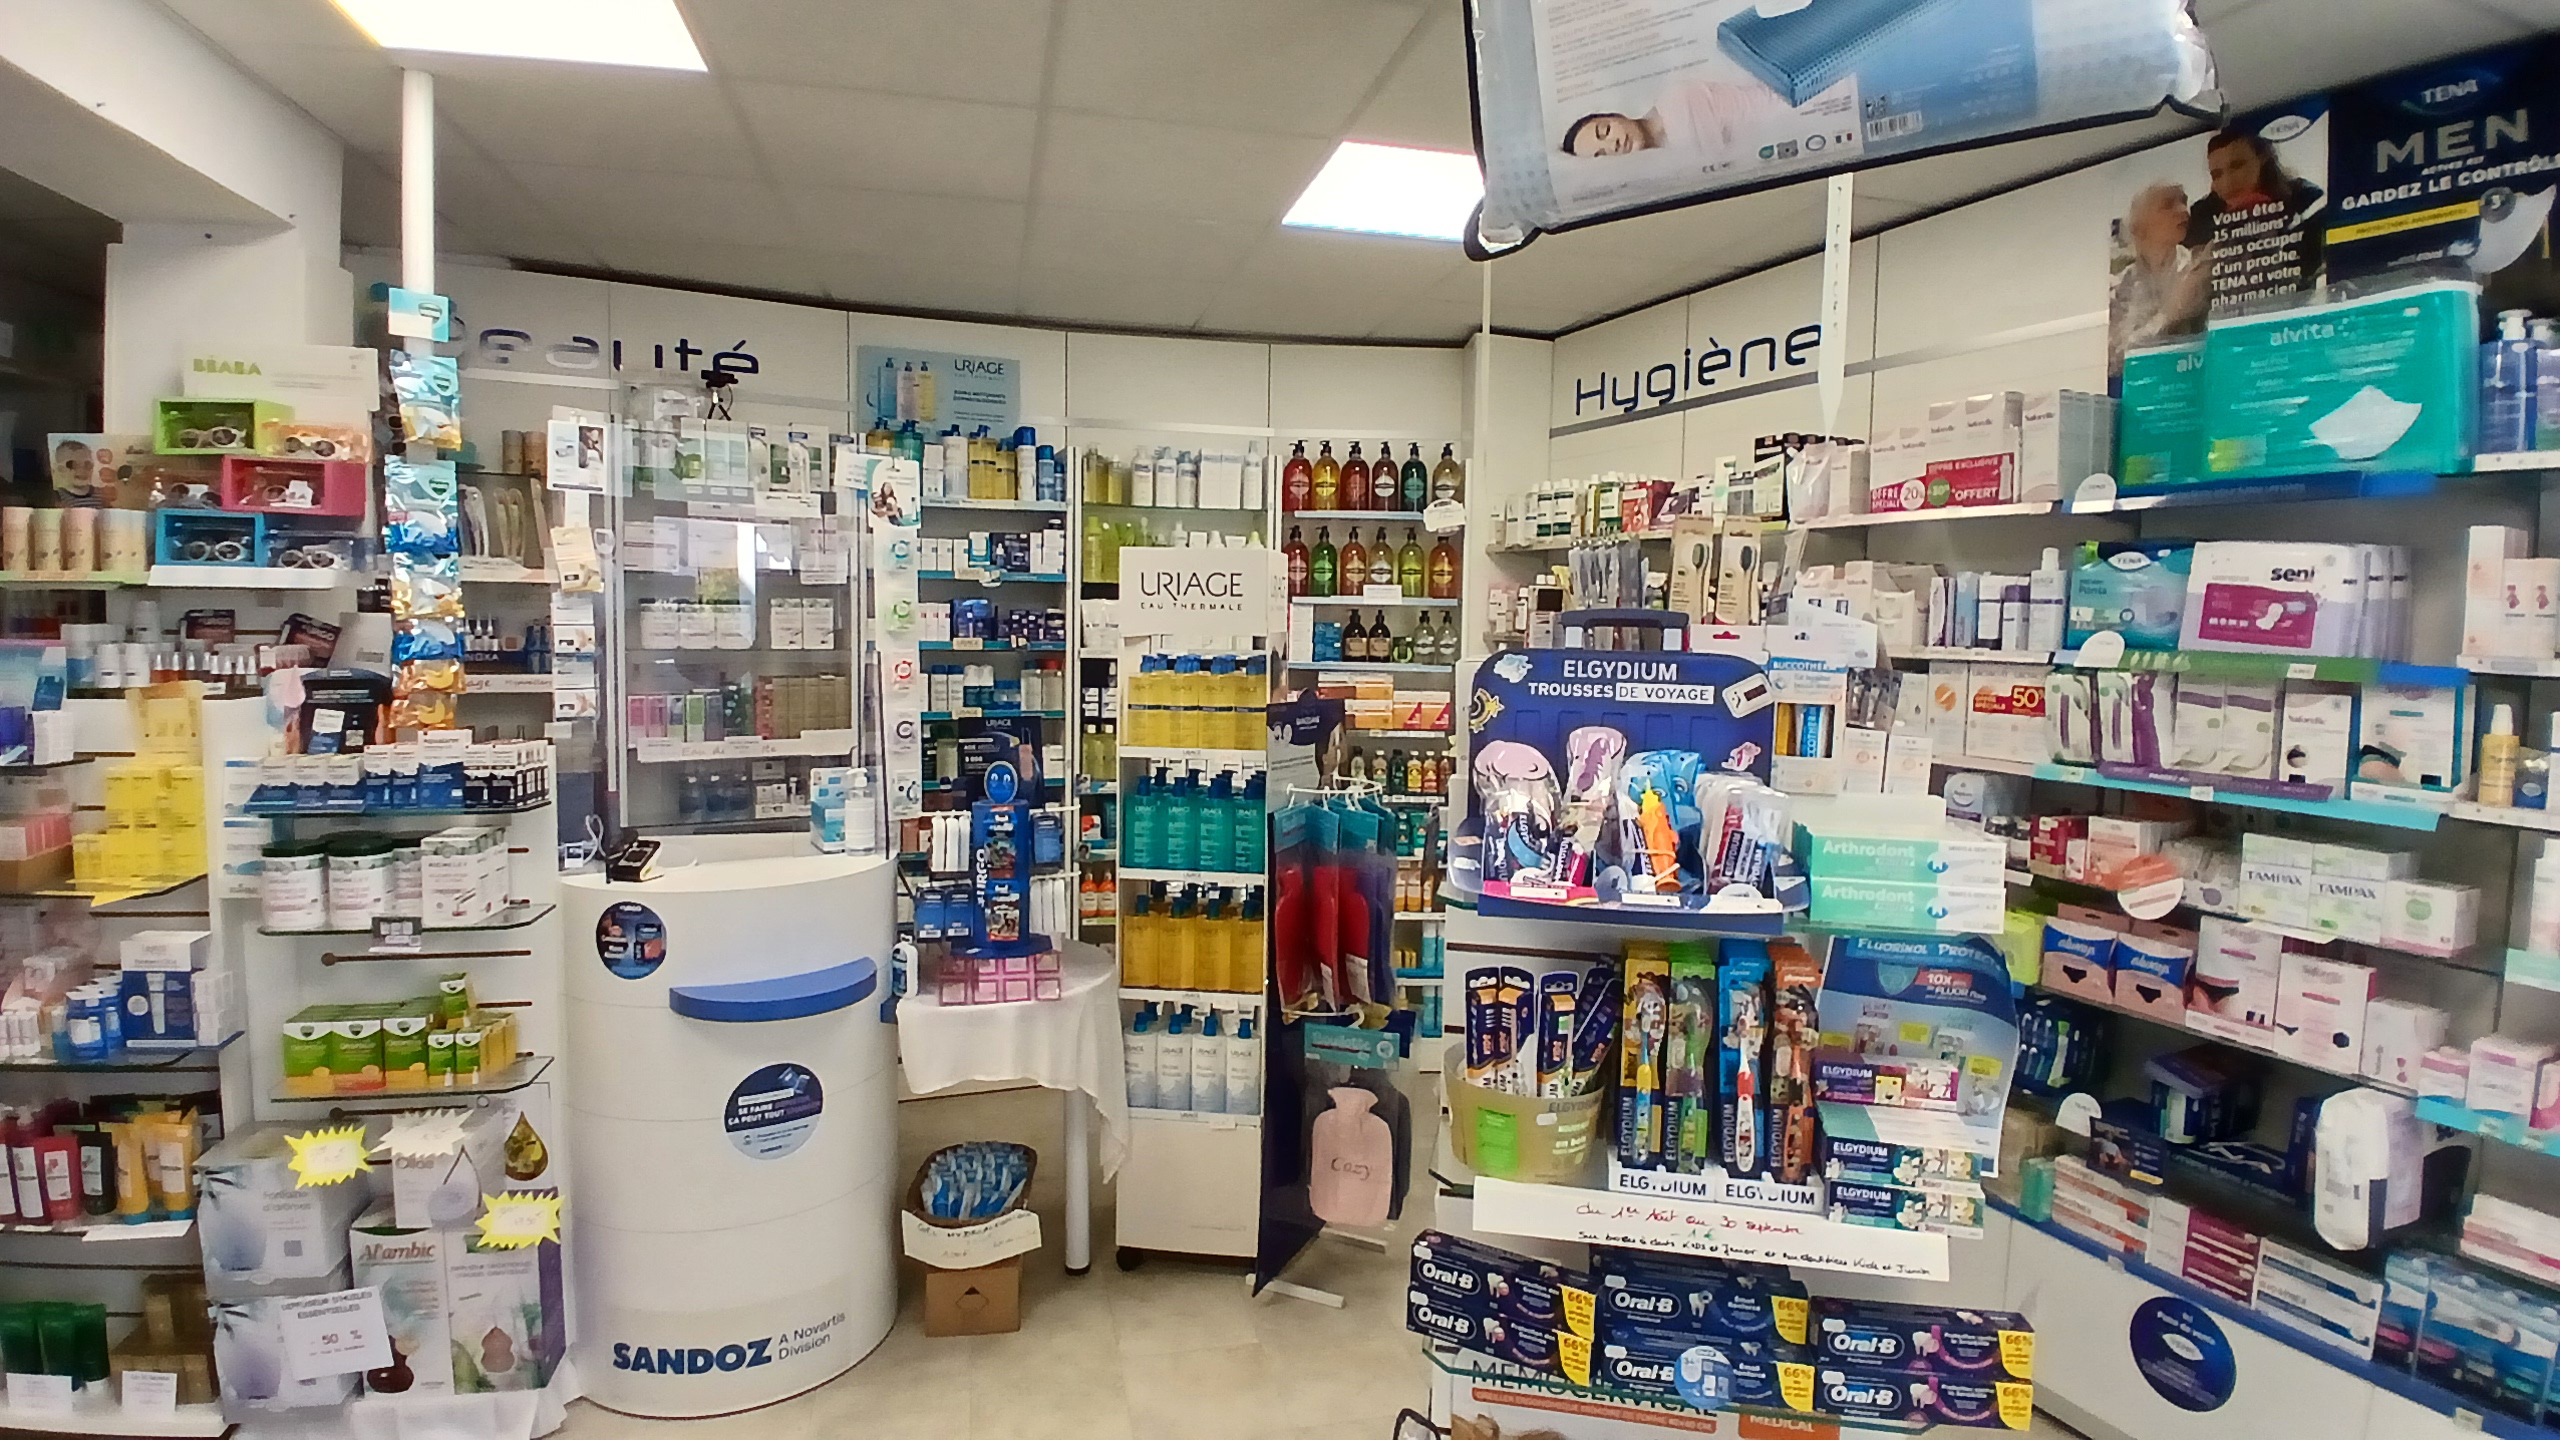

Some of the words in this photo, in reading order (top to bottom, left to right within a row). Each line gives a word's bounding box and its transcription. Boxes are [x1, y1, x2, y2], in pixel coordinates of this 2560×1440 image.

[2423, 79, 2478, 103] TENA
[2377, 108, 2528, 173] MEN
[2342, 182, 2422, 211] GARDEZ
[2428, 175, 2452, 192] LE
[2213, 209, 2249, 226] Vous
[2252, 201, 2285, 217] êtes
[2213, 228, 2229, 244] 15
[2212, 244, 2244, 259] vous
[2211, 274, 2248, 291] TENA
[2250, 272, 2264, 284] et
[2266, 266, 2302, 281] votre
[2212, 261, 2243, 277] d'un
[2211, 283, 2298, 311] pharmacien
[2271, 321, 2336, 346] alvita
[954, 358, 1005, 376] URIAGE
[1575, 322, 1822, 416] Hygiène
[1872, 487, 1899, 502] OFFRE
[2116, 557, 2143, 565] TENA
[2271, 565, 2316, 583] seni
[1141, 571, 1244, 601] URIAGE
[1141, 602, 1164, 610] EAU
[1172, 602, 1243, 611] THERMALE
[1562, 660, 1678, 682] ELGYDIUM
[1528, 682, 1614, 698] TROUSSES
[1619, 686, 1639, 699] DE
[1644, 687, 1711, 702] VOYAGE
[1822, 840, 1916, 859] Arthrodont
[2247, 870, 2303, 887] TAMPAX
[1821, 885, 1915, 904] Arthrodont
[2318, 883, 2377, 900] TAMPAX
[1857, 938, 1928, 955] FLUORINOL
[2057, 936, 2096, 957] always
[2130, 955, 2170, 976] always
[1926, 973, 1953, 985] 10X
[1934, 986, 1969, 997] FLUOR
[1822, 1065, 1873, 1078] ELGYDIUM
[1620, 1096, 1633, 1157] ELGYDIUM
[1666, 1100, 1678, 1161] ELGYDIUM
[1724, 1103, 1736, 1163] ELGYDIUM
[1770, 1107, 1783, 1168] ELGYDIUM
[1833, 1141, 1889, 1156] ELGYDIUM
[1330, 1156, 1371, 1182] Cozy
[1619, 1174, 1707, 1196] ELGIUM
[1725, 1183, 1816, 1206] ELGIUM
[1836, 1186, 1892, 1201] ELGYDIUM
[1720, 1215, 1737, 1229] 30
[1422, 1262, 1474, 1289] Oral-B
[1567, 1291, 1594, 1308] 66%
[1615, 1292, 1673, 1312] Oral-B
[1777, 1299, 1807, 1314] 66%
[1418, 1307, 1471, 1334] Oral-B
[321, 1332, 340, 1345] 50
[349, 1328, 363, 1341] %
[613, 1337, 773, 1375] SANDOZ
[778, 1333, 789, 1346] A
[793, 1312, 847, 1341] Novartis
[779, 1332, 832, 1360] Division
[1562, 1337, 1590, 1354] 66%
[1834, 1334, 1897, 1354] Oral-B
[2005, 1334, 2033, 1347] 66%
[1616, 1361, 1675, 1382] Oral-B
[1783, 1366, 1812, 1380] 66%
[1830, 1385, 1893, 1406] Oral-B
[2002, 1386, 2031, 1399] 66%
[1749, 1416, 1816, 1432] MEDICAL
